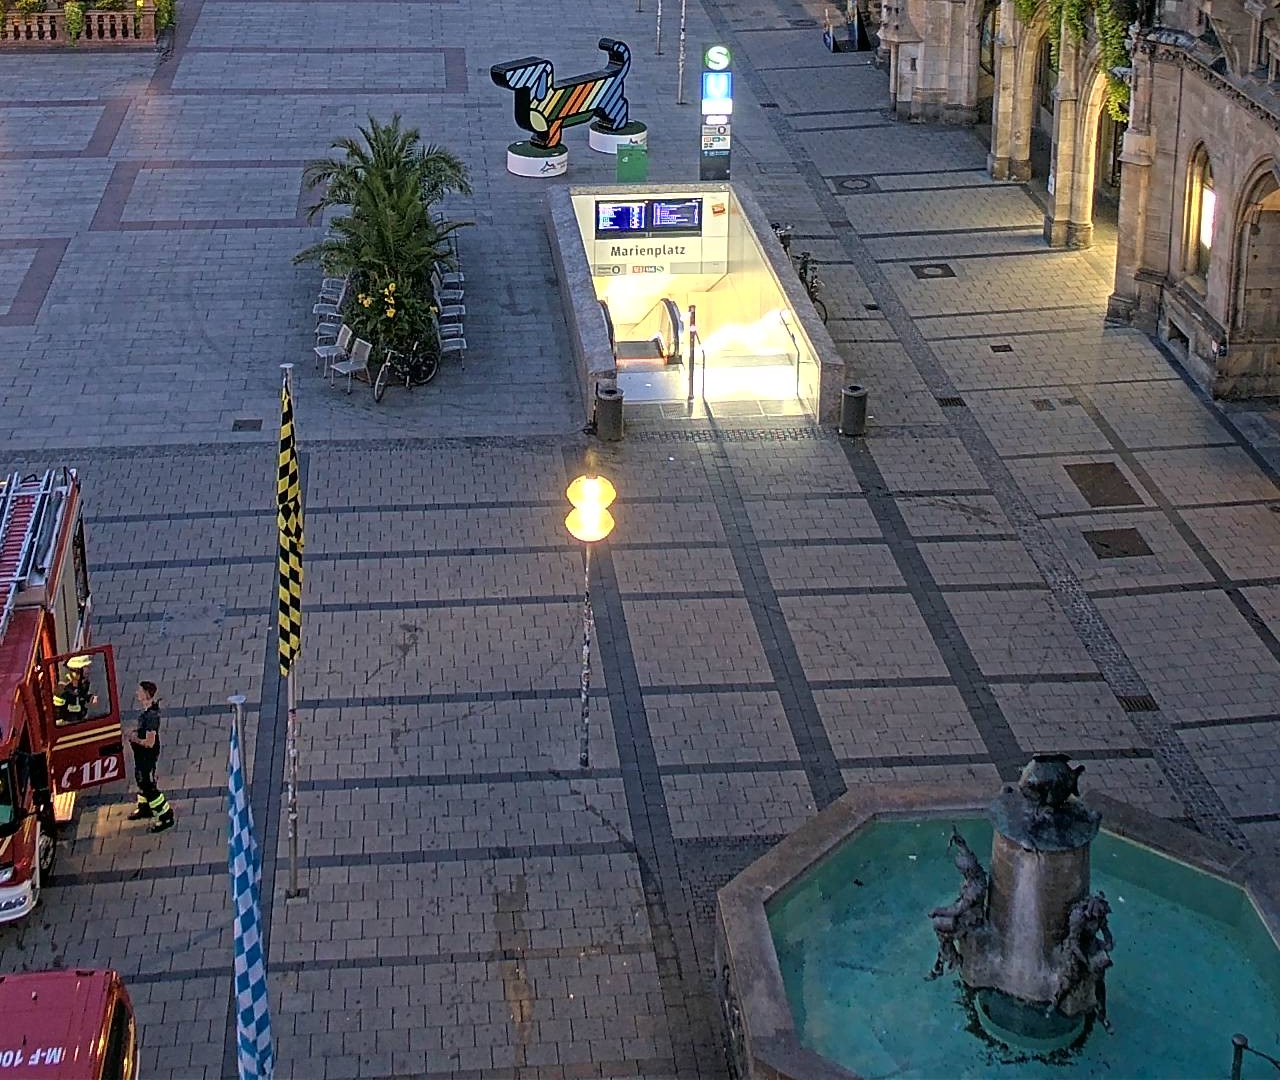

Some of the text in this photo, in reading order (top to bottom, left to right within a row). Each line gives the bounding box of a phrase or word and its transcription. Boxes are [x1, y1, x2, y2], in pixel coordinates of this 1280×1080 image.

[707, 46, 729, 70] S
[610, 244, 687, 258] Marienplatz
[80, 756, 119, 786] 112
[28, 1047, 63, 1066] M-F
